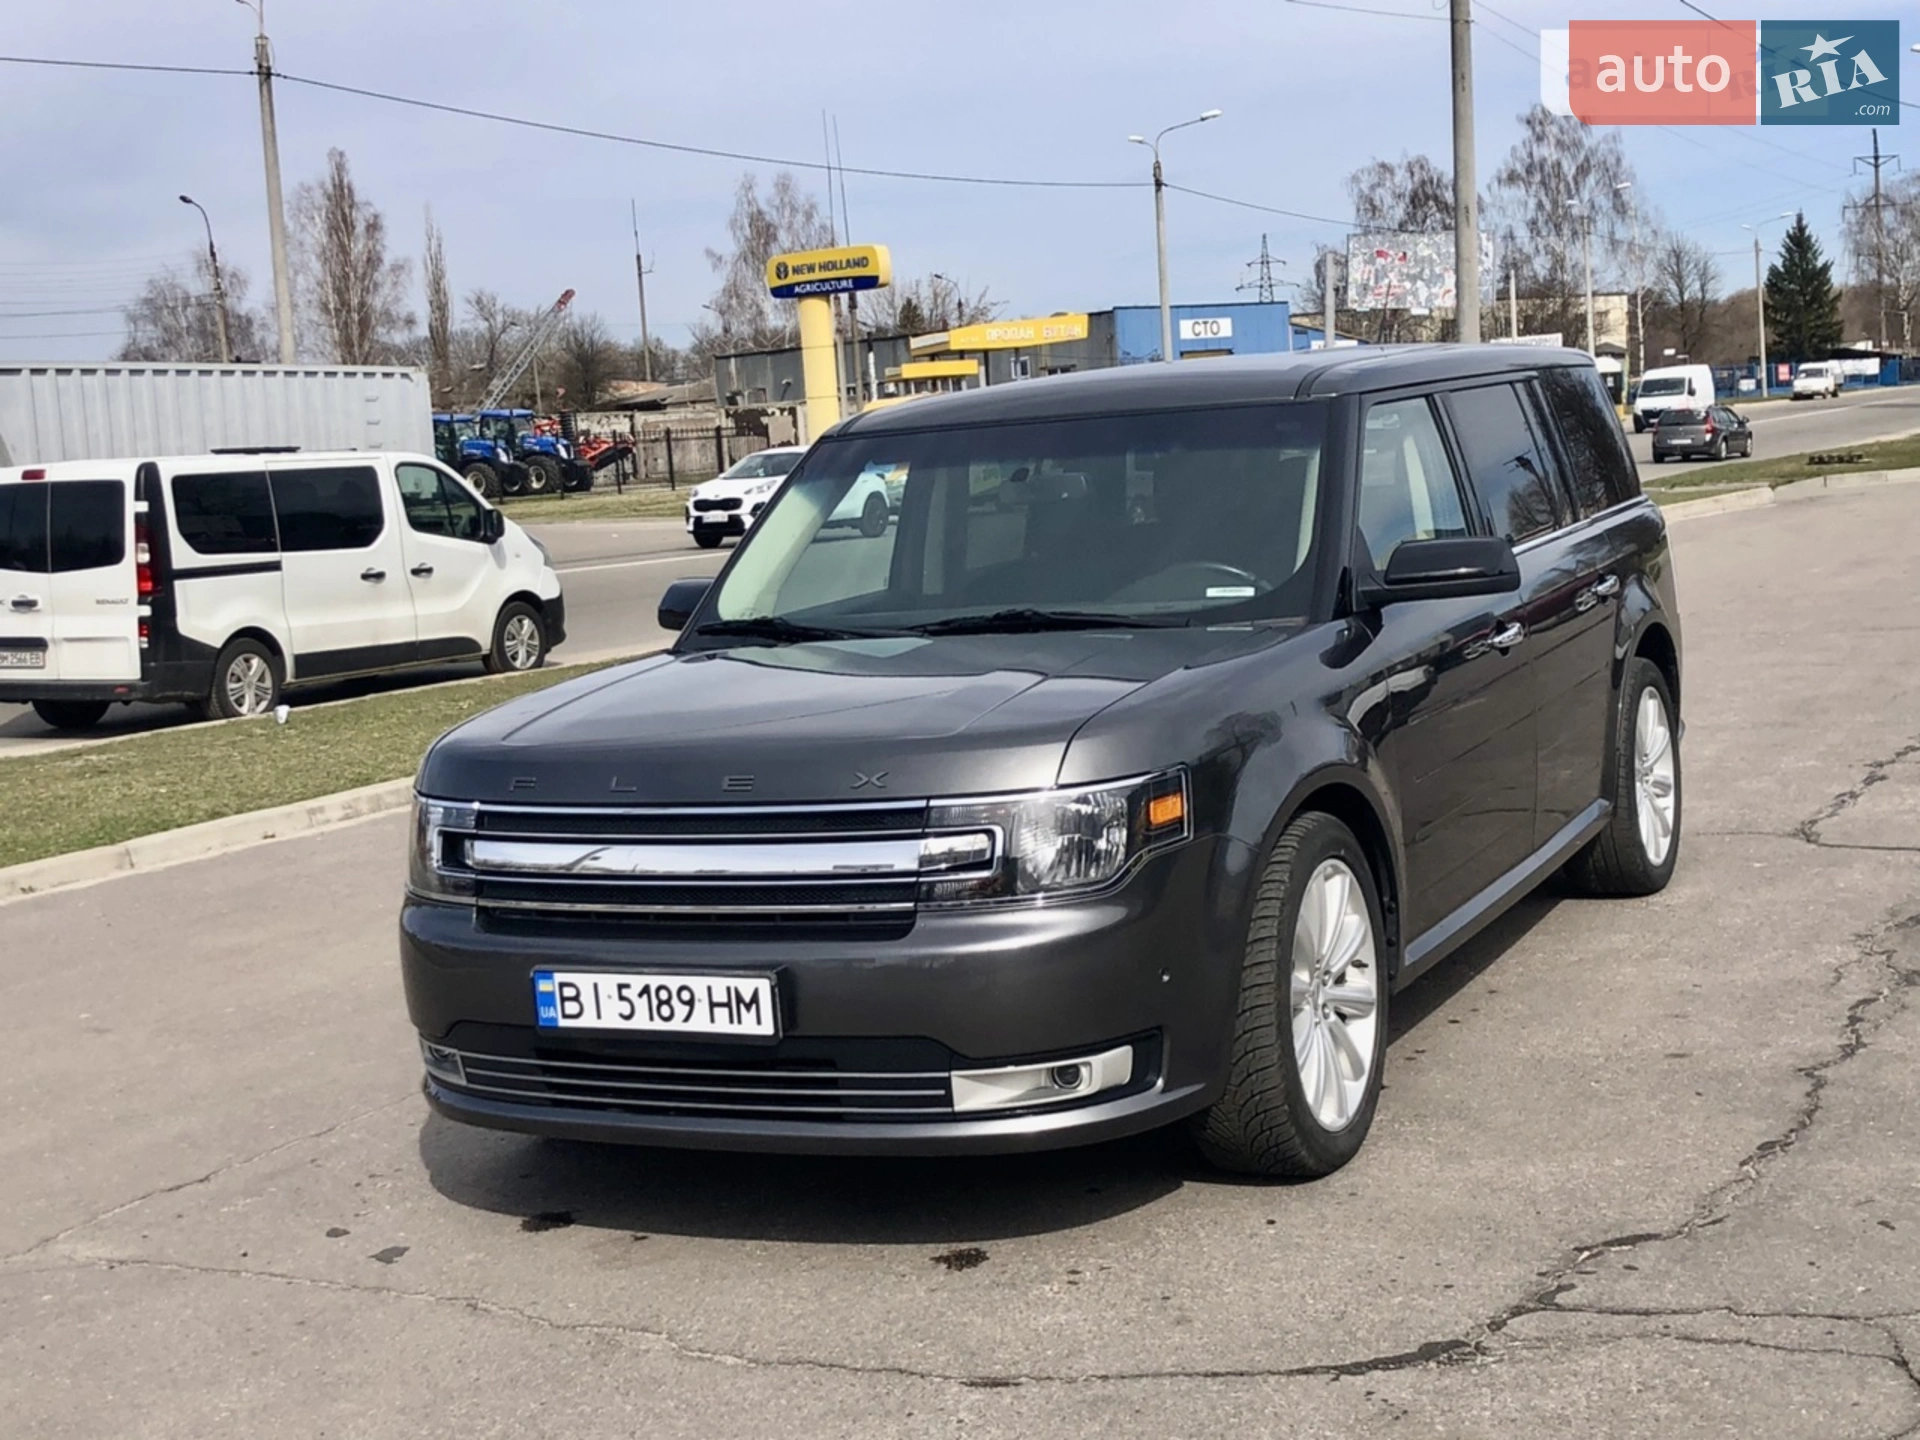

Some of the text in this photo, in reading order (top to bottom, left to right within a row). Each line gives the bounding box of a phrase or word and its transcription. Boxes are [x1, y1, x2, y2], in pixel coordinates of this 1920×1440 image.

[792, 256, 869, 276] NEW HOLLAND
[794, 279, 854, 294] AGRICULTURE
[1192, 320, 1221, 337] СТО
[95, 598, 129, 606] RENAULT
[509, 770, 889, 793] FLEX
[541, 1005, 557, 1019] UA
[616, 983, 696, 1023] 5189
[706, 985, 763, 1027] HM
